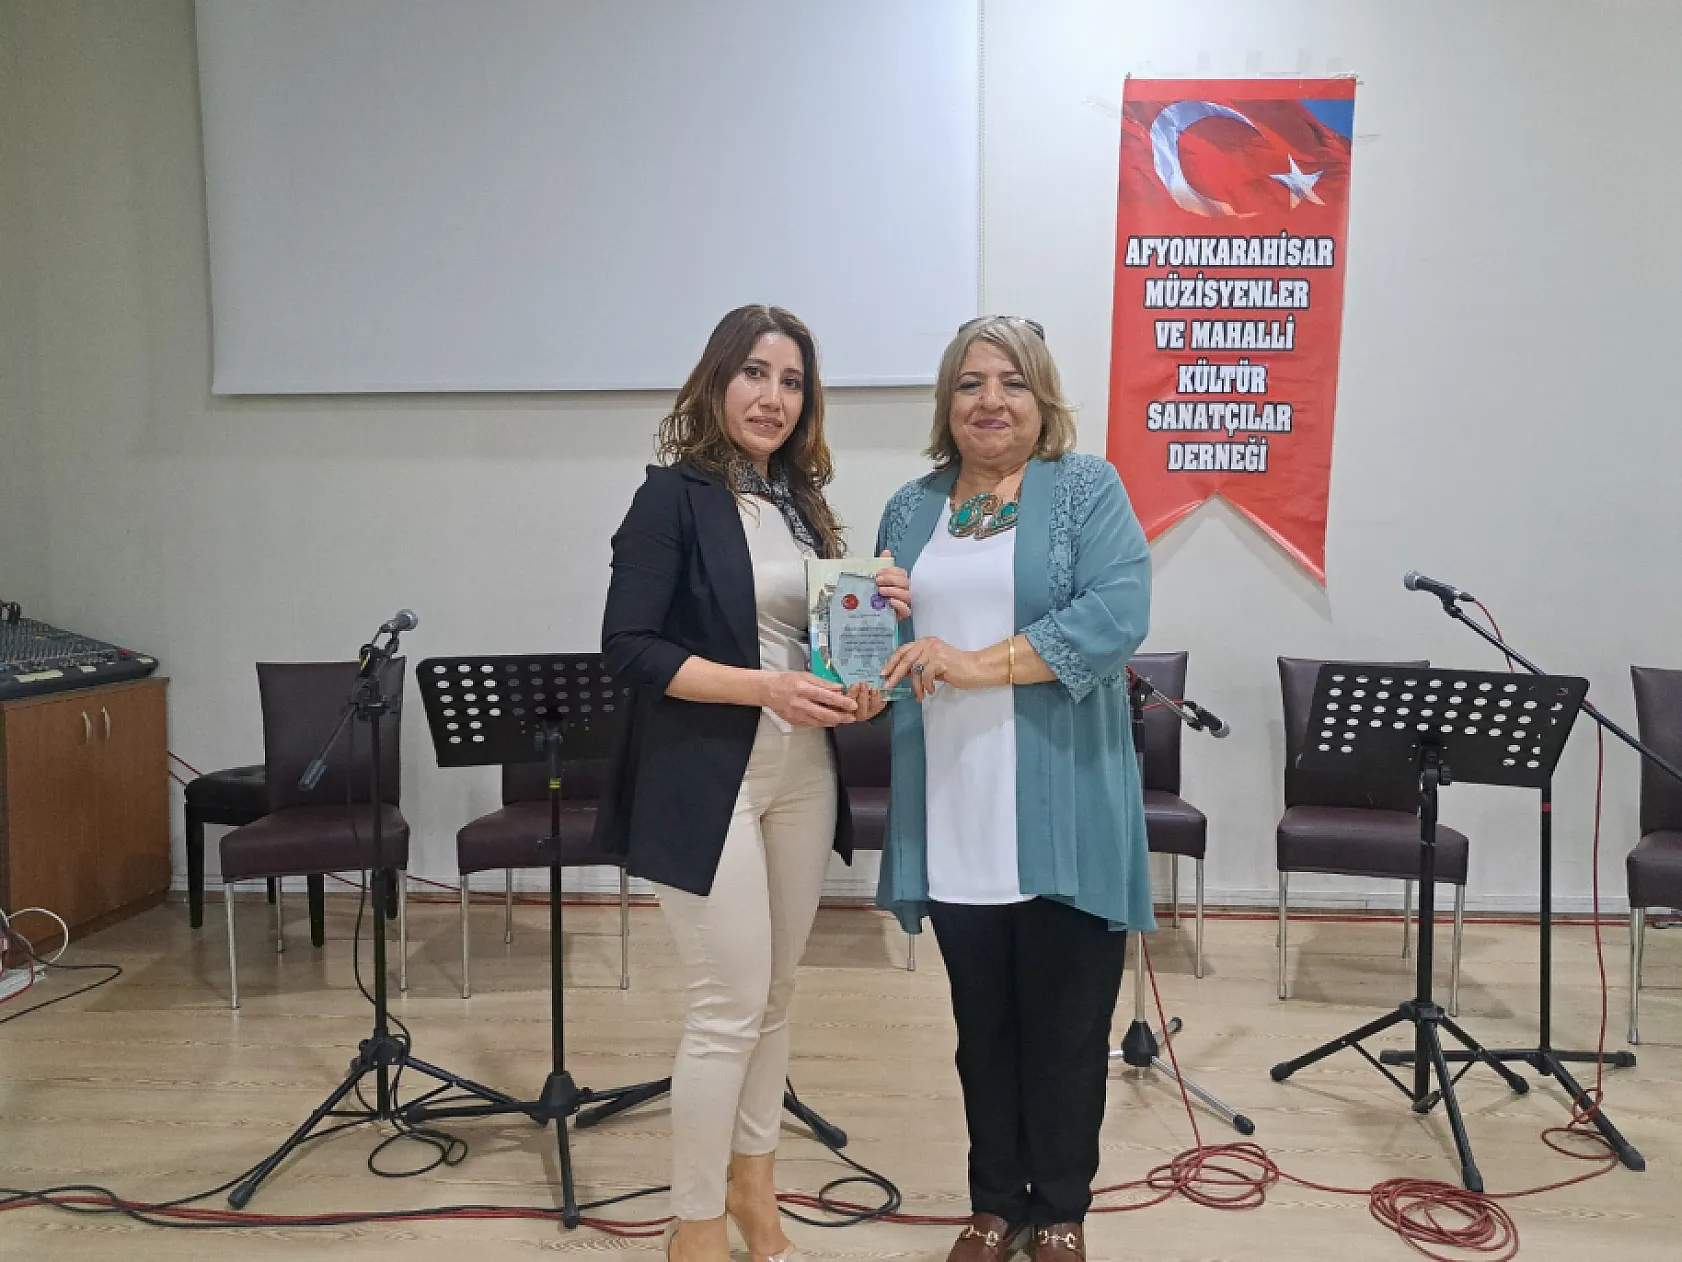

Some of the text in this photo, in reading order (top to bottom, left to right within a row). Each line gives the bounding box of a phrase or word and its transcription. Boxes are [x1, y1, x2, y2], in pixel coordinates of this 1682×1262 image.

[1125, 229, 1334, 267] AFYONKARAHİSAR
[1144, 271, 1310, 309] MÜZİSYENLER
[1155, 313, 1295, 350] VE MAHALLİ
[1176, 357, 1267, 393] KÜLTÜR
[1147, 402, 1292, 437] SANATÇILAR
[1167, 436, 1268, 471] DERNEĞİ
